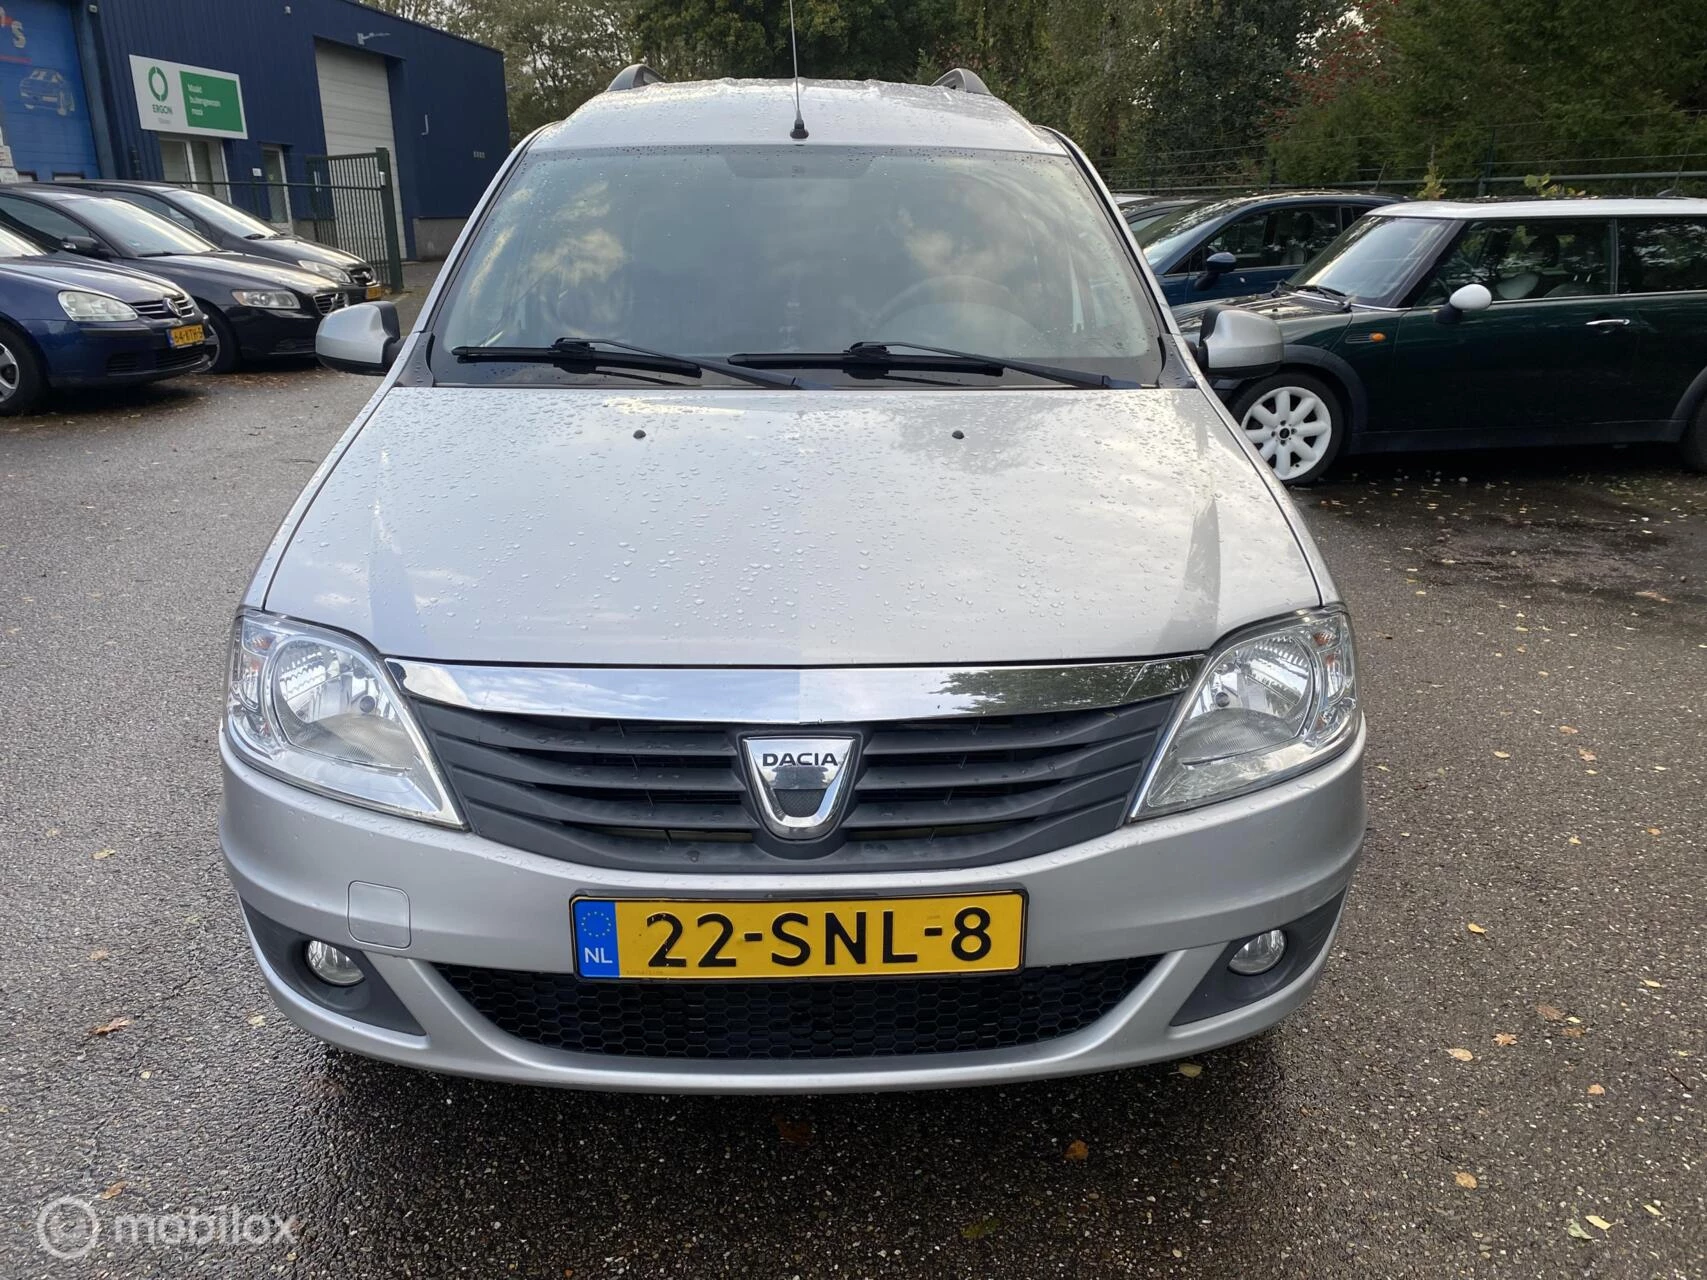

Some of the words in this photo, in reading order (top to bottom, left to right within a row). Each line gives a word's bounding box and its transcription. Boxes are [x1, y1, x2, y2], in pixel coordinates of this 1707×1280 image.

[152, 104, 173, 115] ERGON
[762, 753, 838, 766] DACIA
[646, 907, 992, 967] 22-SNL-8
[584, 947, 613, 964] NL
